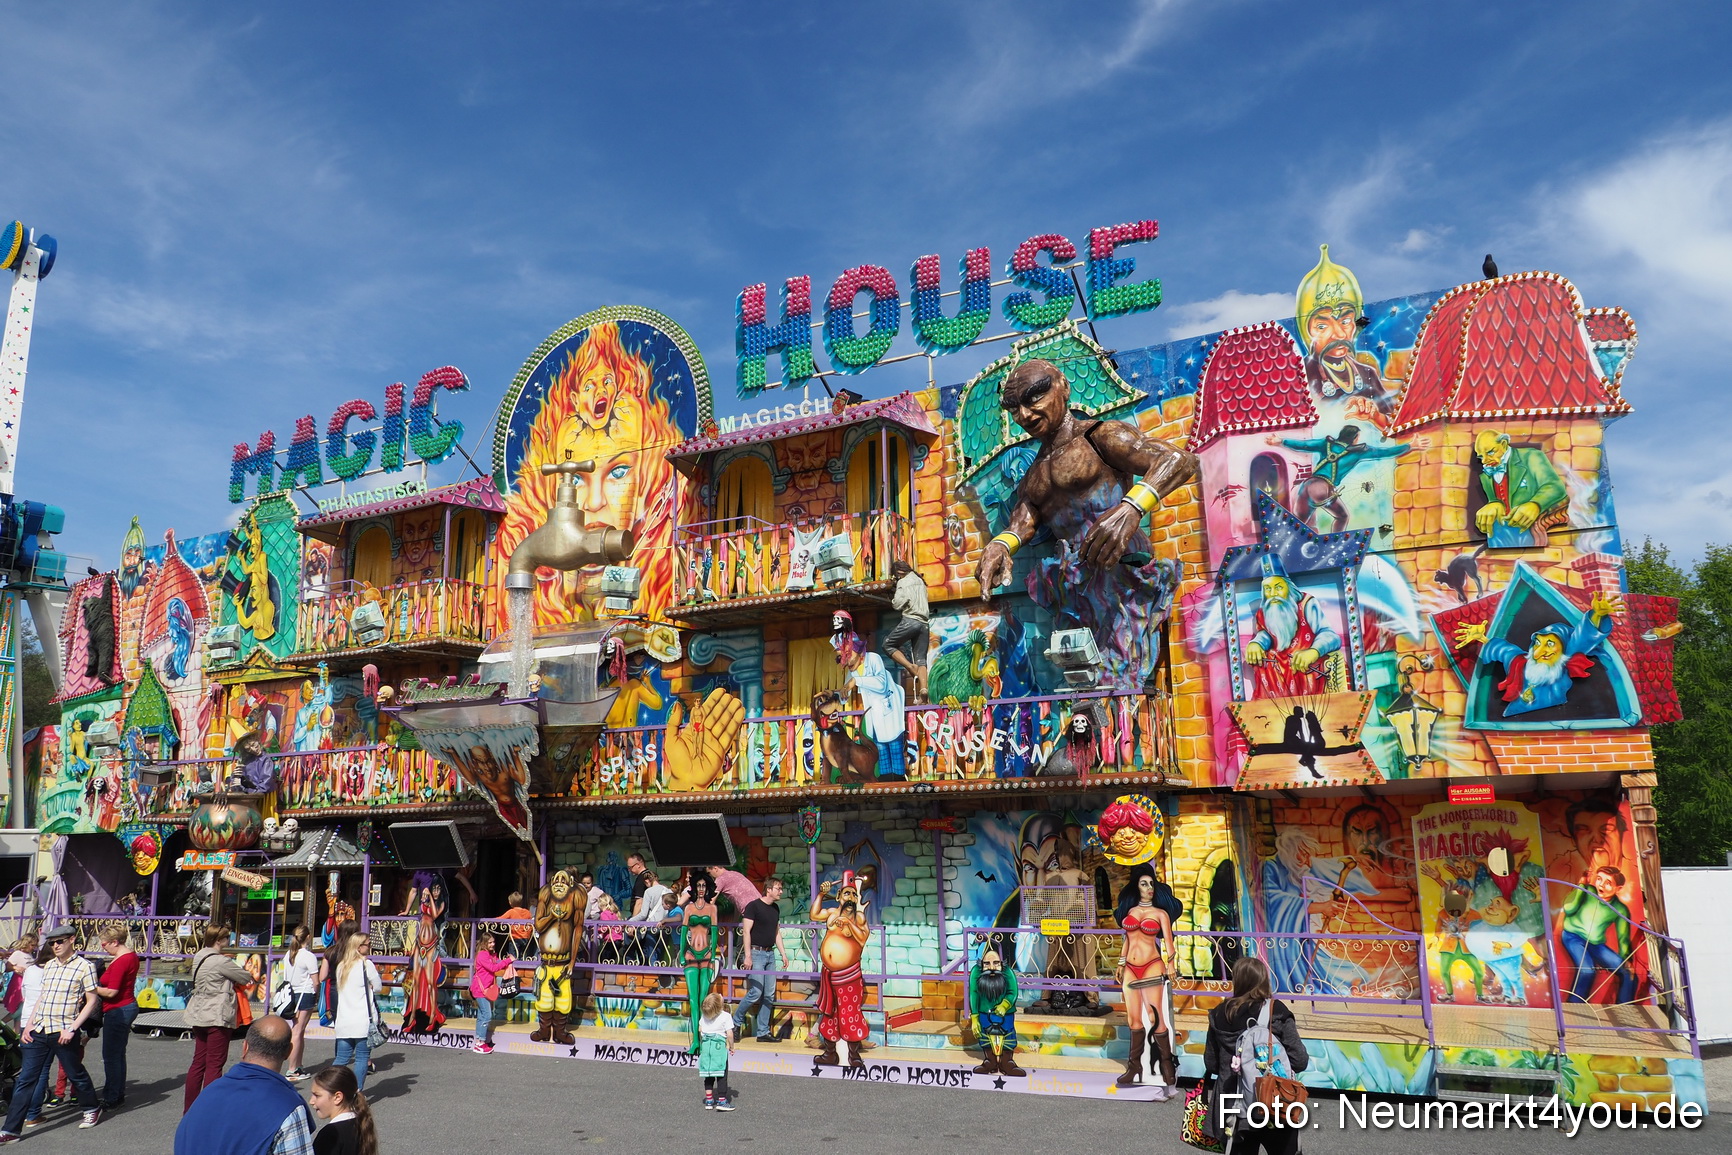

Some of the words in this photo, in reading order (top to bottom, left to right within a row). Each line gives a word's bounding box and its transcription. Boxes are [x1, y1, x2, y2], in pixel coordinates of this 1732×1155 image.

[229, 365, 471, 504] MAGIC
[735, 219, 1162, 401] HOUSE
[720, 396, 829, 435] MAGISCH
[318, 479, 429, 514] PHANTASTISCH
[922, 710, 1051, 767] GRUSELN
[599, 742, 657, 784] SPASS
[1417, 818, 1437, 832] THE
[1438, 808, 1518, 825] WONDERWORLD
[1461, 821, 1472, 831] OF
[183, 850, 236, 867] KASSE
[1418, 831, 1487, 862] MAGIC
[226, 868, 256, 886] EINGANG
[387, 1029, 428, 1046] MAGIC
[430, 1032, 475, 1050] HOUSE
[594, 1043, 641, 1064] MAGIC
[645, 1047, 700, 1068] HOUSE
[742, 1058, 794, 1074] gruseln
[842, 1062, 902, 1084] MAGIC
[907, 1066, 974, 1088] HOUSE
[1027, 1074, 1084, 1094] lachen
